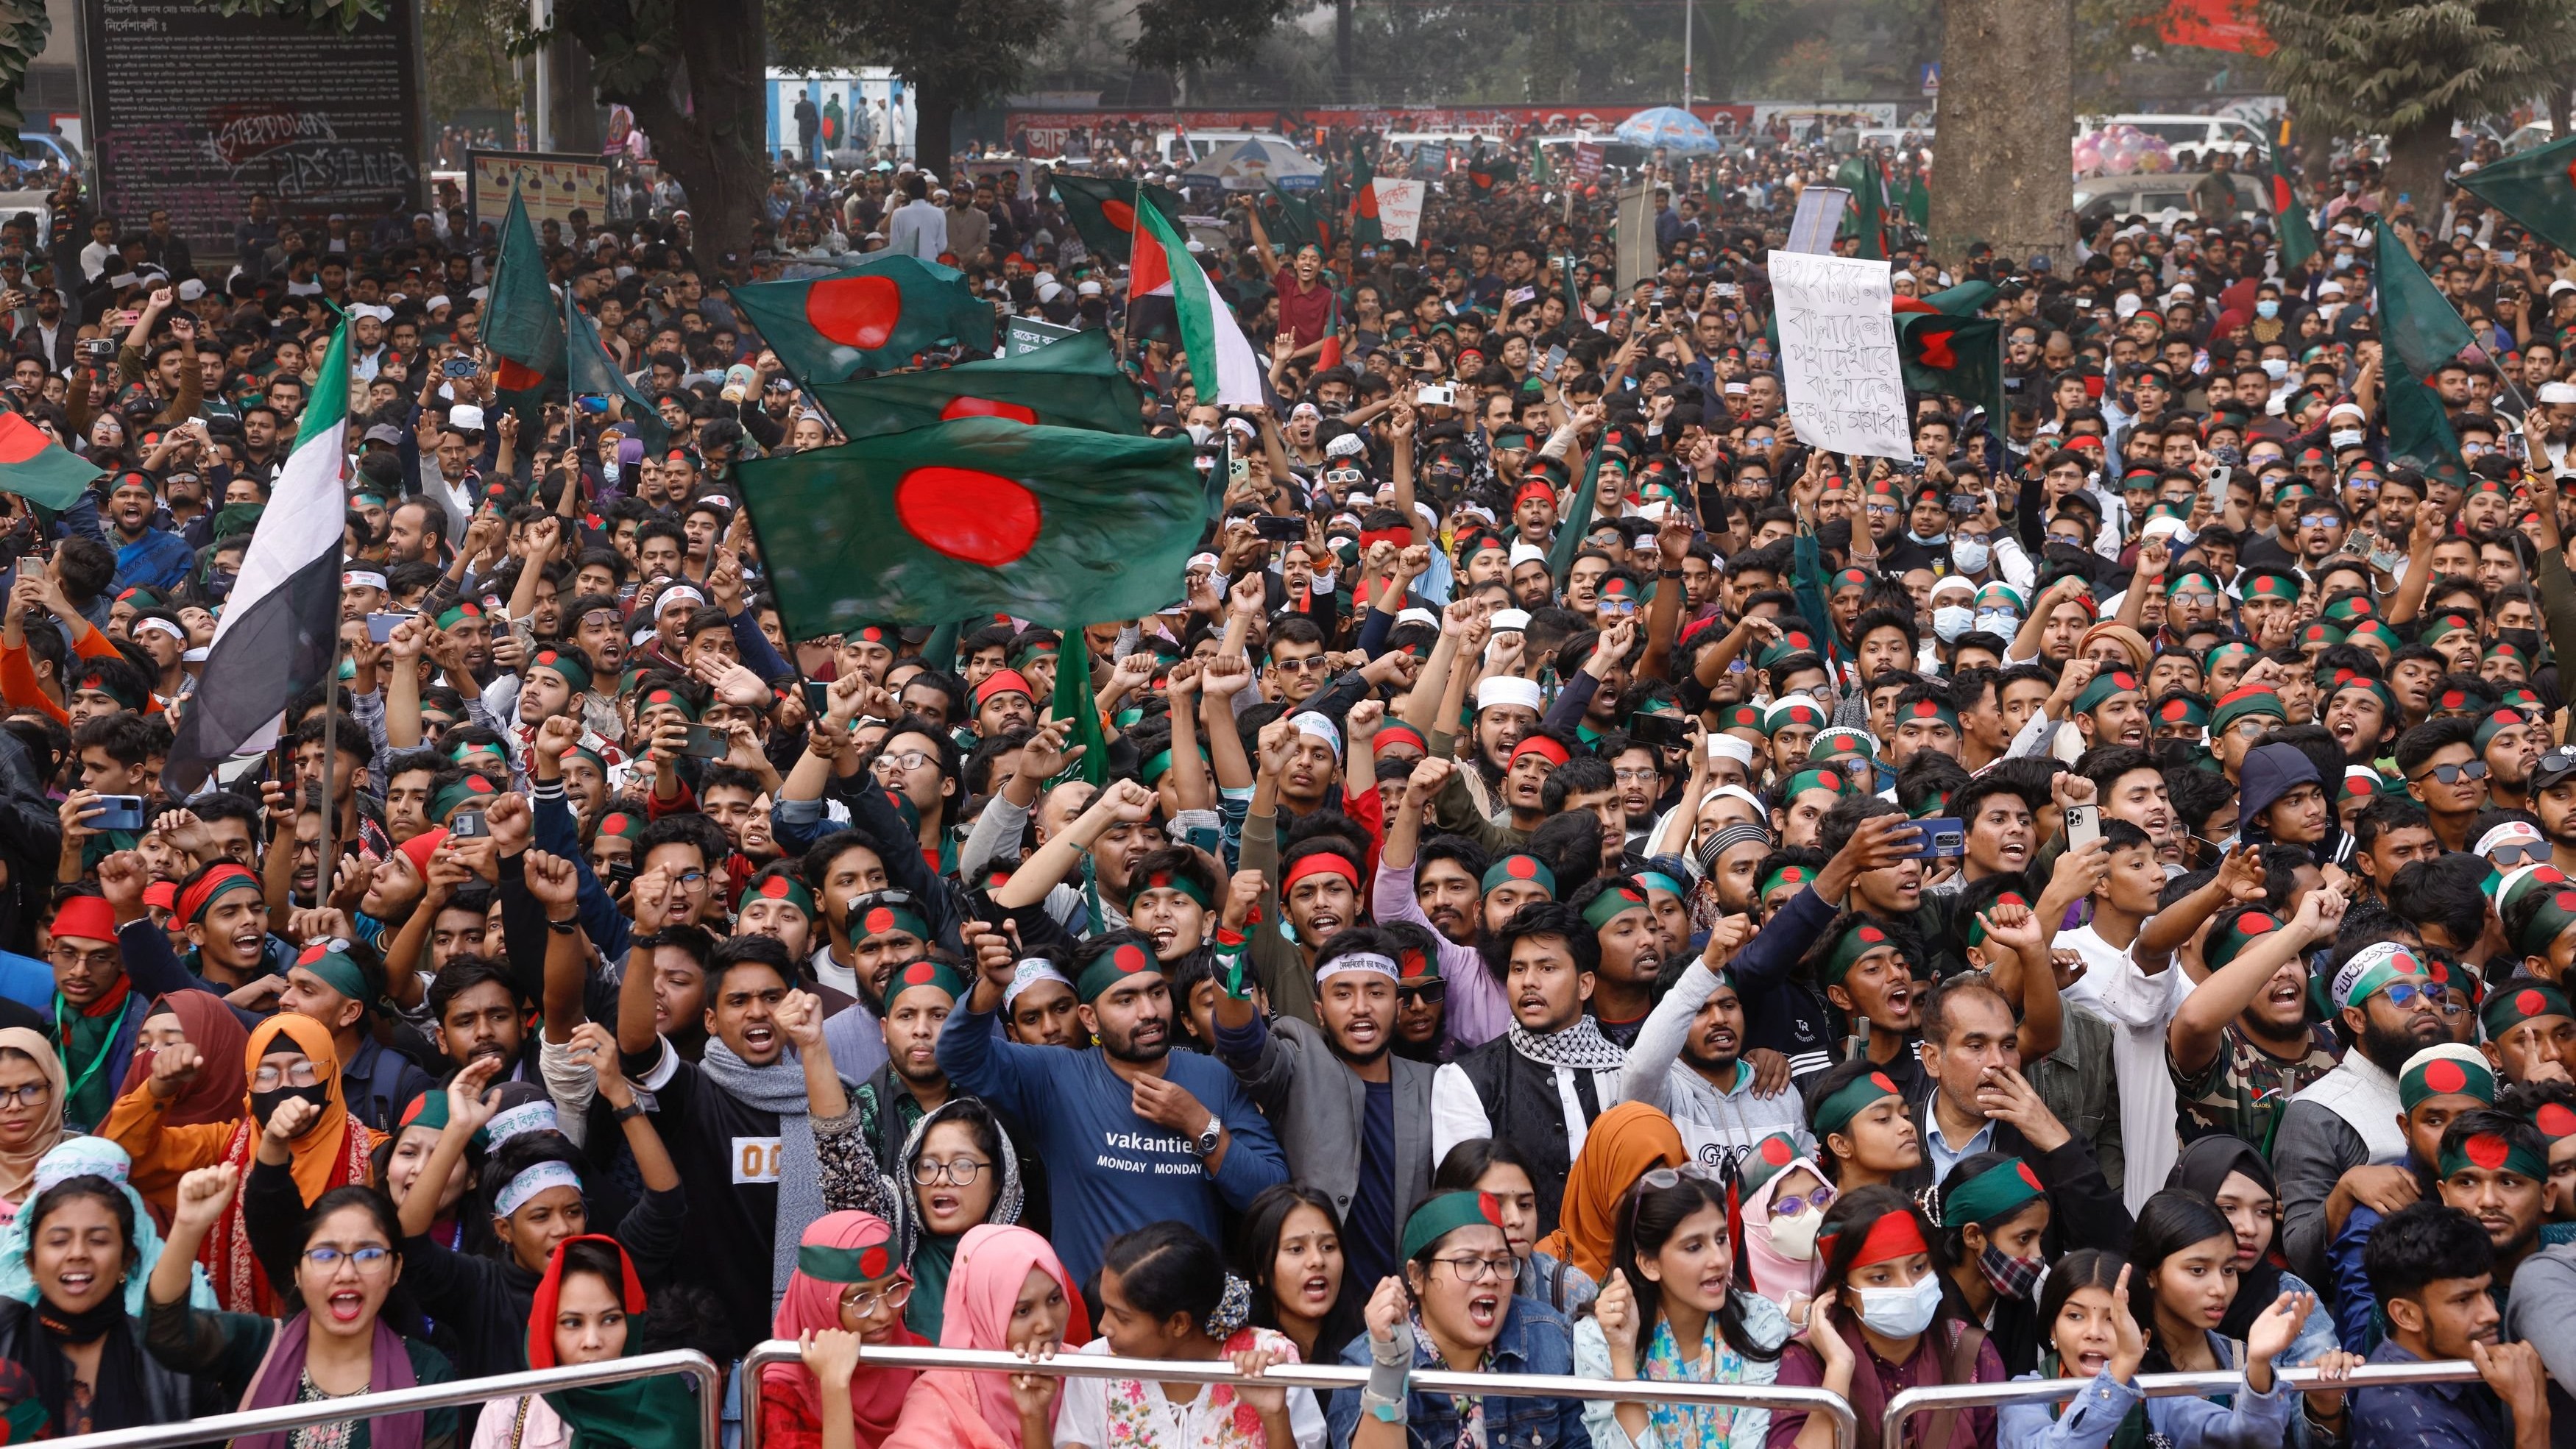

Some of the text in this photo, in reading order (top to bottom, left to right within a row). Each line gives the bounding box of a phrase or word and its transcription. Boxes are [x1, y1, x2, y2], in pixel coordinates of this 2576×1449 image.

[105, 18, 158, 32] নির্দেশাবলী
[1105, 1132, 1192, 1154] vakantie
[1097, 1155, 1202, 1175] MONDAY MONDAY
